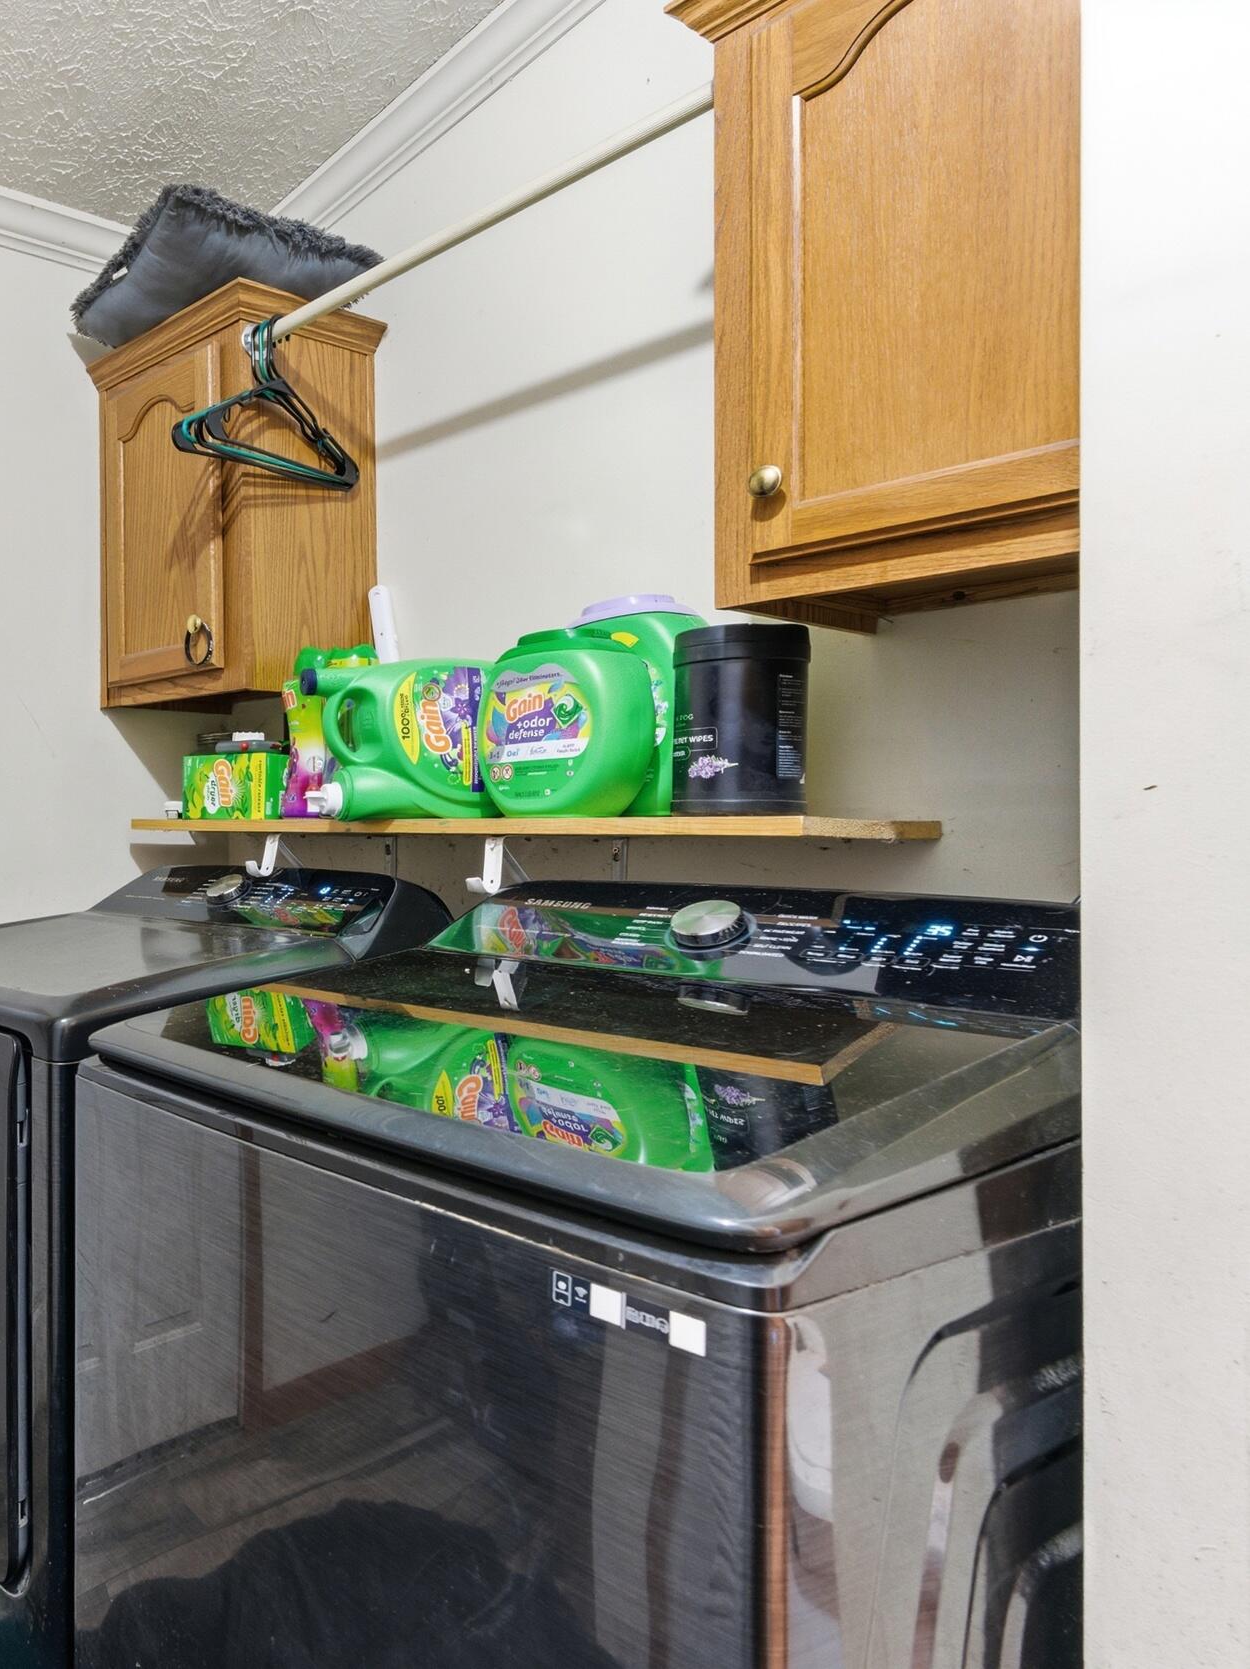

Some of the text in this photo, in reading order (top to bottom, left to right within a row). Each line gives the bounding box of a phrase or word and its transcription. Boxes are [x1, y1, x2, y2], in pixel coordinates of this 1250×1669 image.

[506, 692, 544, 723] Gain
[421, 699, 452, 753] Gain
[508, 728, 545, 741] defense
[688, 734, 714, 744] WIPES
[214, 759, 233, 807] Gain
[524, 897, 592, 911] SAMSUNG
